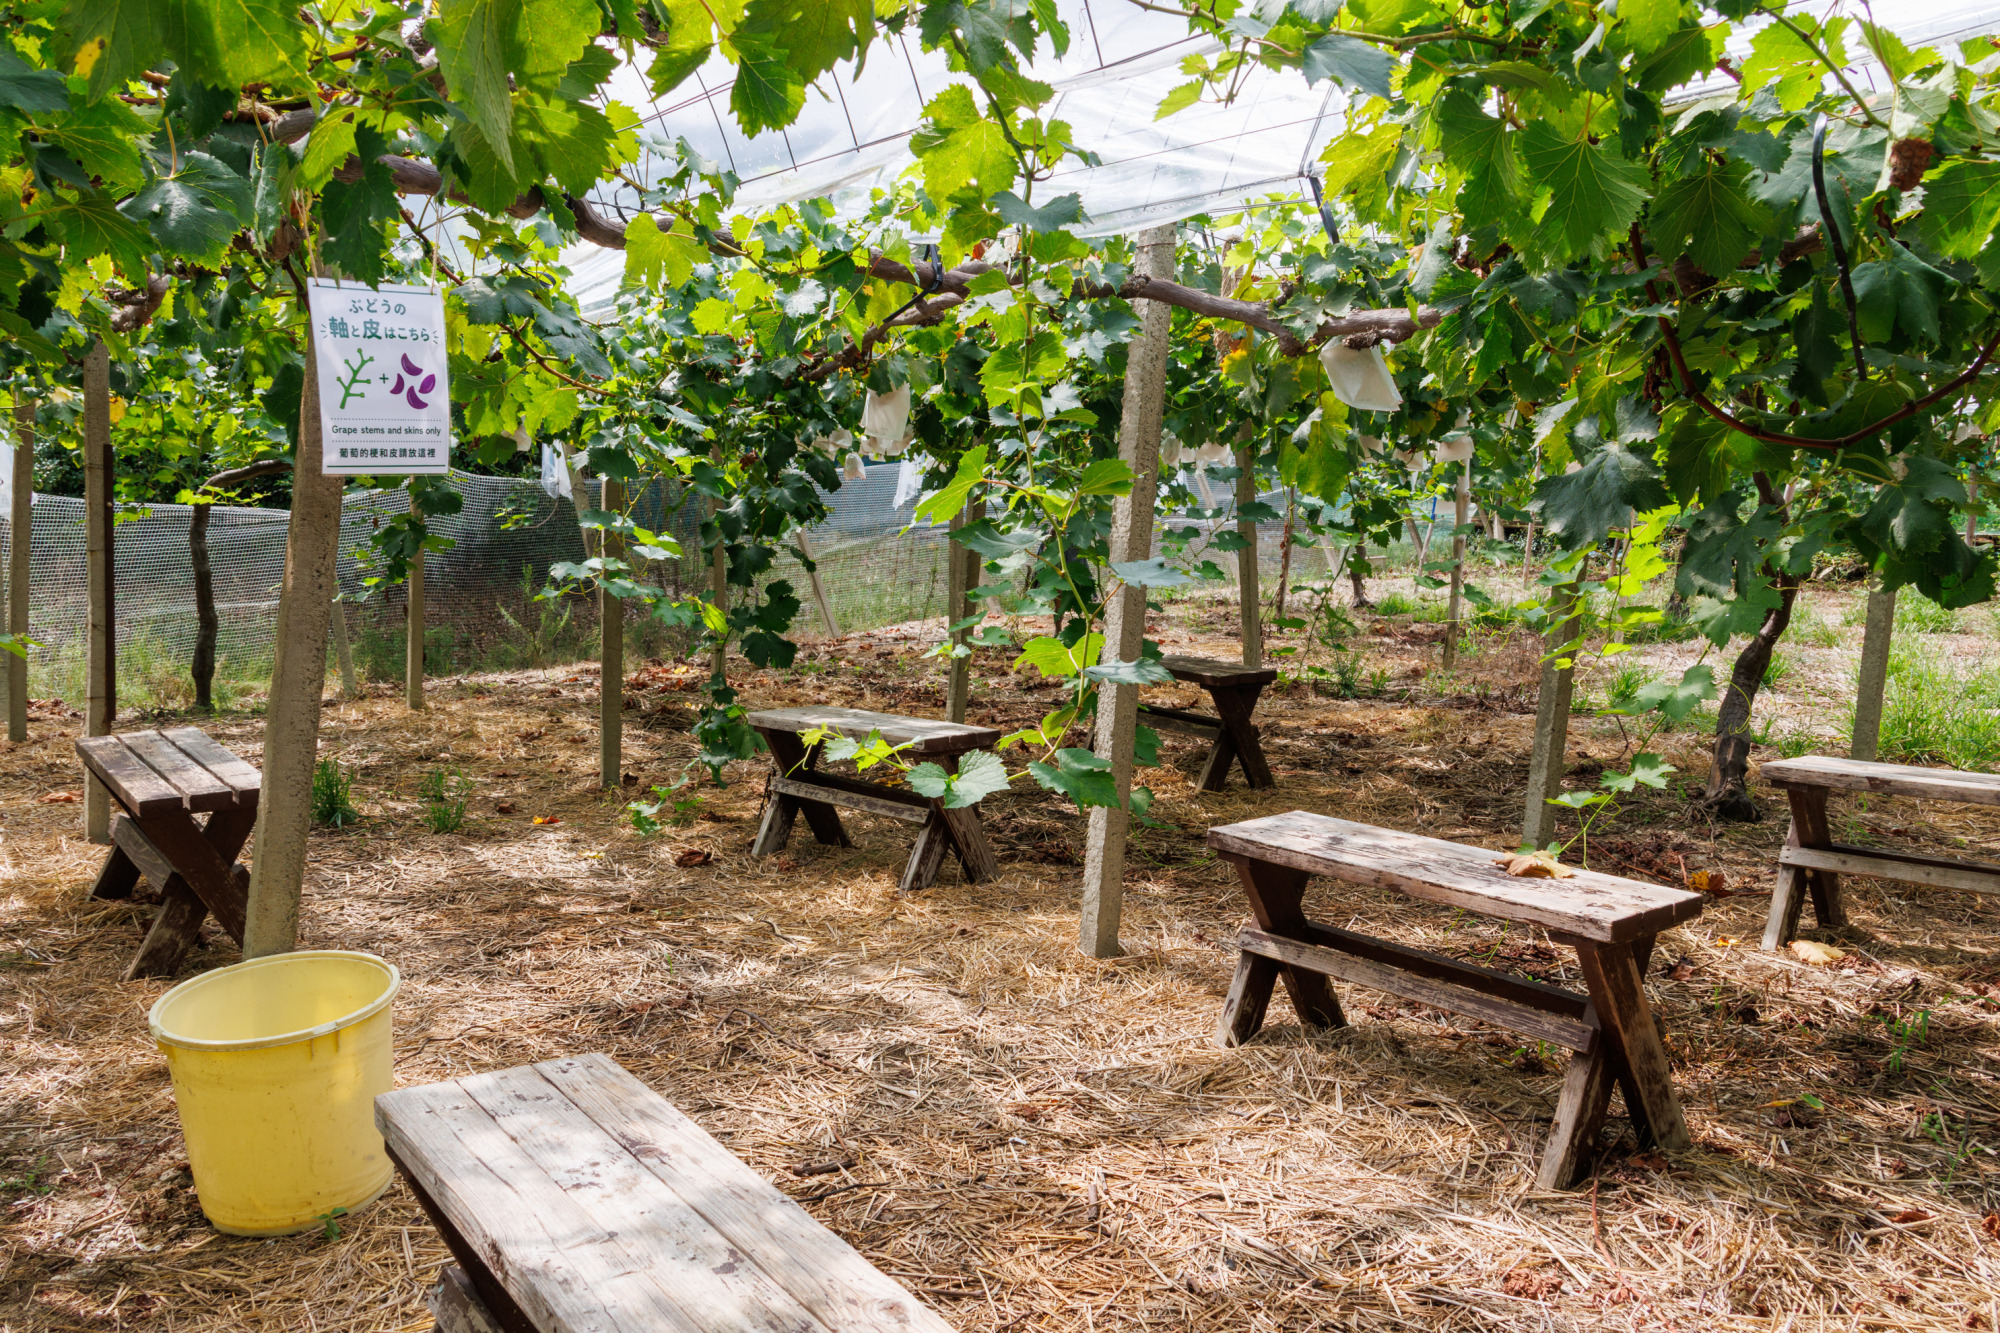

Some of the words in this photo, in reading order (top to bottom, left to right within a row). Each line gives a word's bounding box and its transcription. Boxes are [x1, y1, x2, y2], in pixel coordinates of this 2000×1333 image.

[349, 298, 406, 315] ぶどうの
[328, 316, 430, 341] 軸と皮はこちら
[332, 425, 357, 435] Grape
[361, 426, 385, 434] stems
[387, 426, 402, 434] and
[404, 427, 423, 435] skins
[425, 427, 441, 436] only
[339, 448, 436, 458] 葡萄的梗和皮請放這裡
